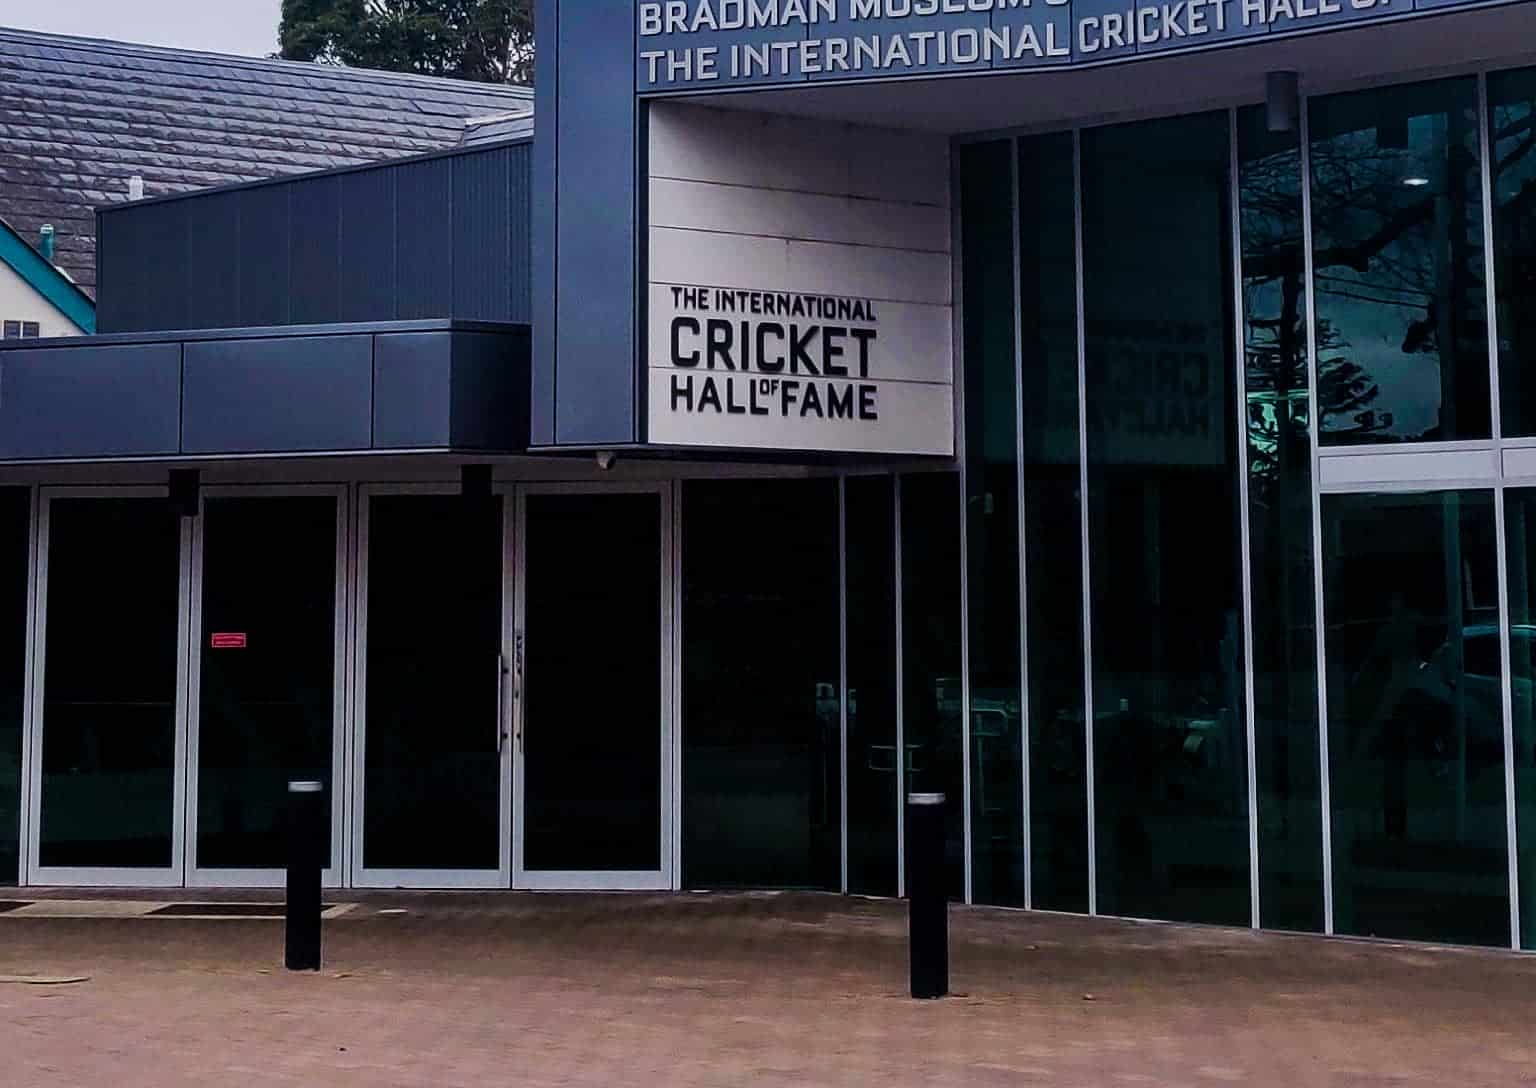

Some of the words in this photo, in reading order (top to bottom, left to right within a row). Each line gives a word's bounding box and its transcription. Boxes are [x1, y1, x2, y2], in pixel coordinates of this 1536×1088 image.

[639, 46, 719, 83] THE
[730, 23, 1071, 78] INTERNATIONAL
[670, 286, 710, 310] THE
[715, 289, 877, 322] INTERNATIONAL
[670, 316, 877, 377] CRICKET
[670, 374, 769, 416] HALL
[759, 378, 779, 396] OF
[781, 380, 878, 421] FAME
